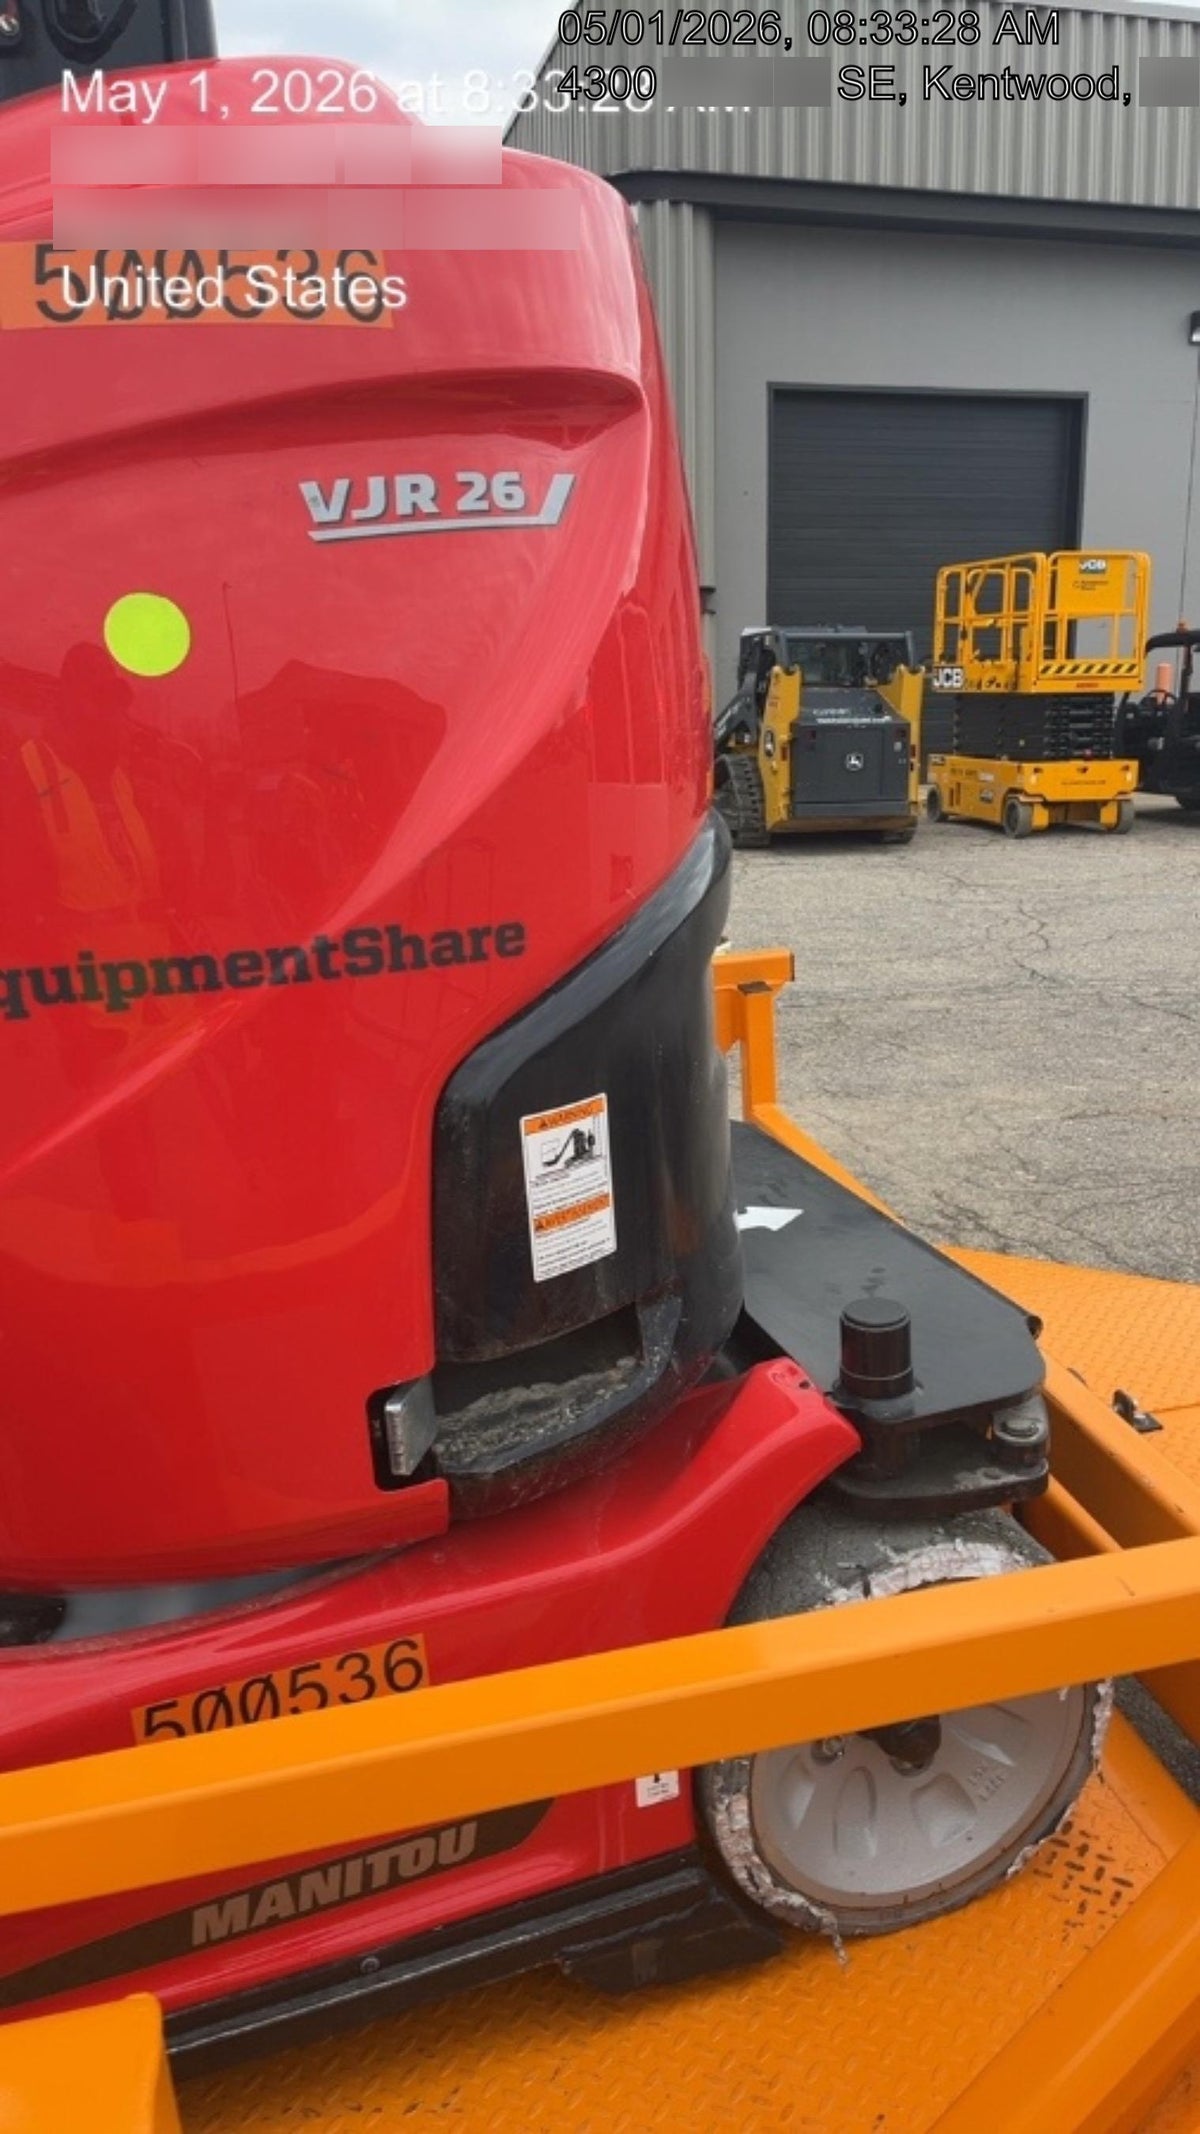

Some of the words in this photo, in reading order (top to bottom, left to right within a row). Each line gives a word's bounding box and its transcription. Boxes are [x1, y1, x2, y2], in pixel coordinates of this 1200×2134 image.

[299, 474, 440, 524] VJR
[455, 471, 526, 512] 26
[191, 1821, 478, 1946] MANITOU
